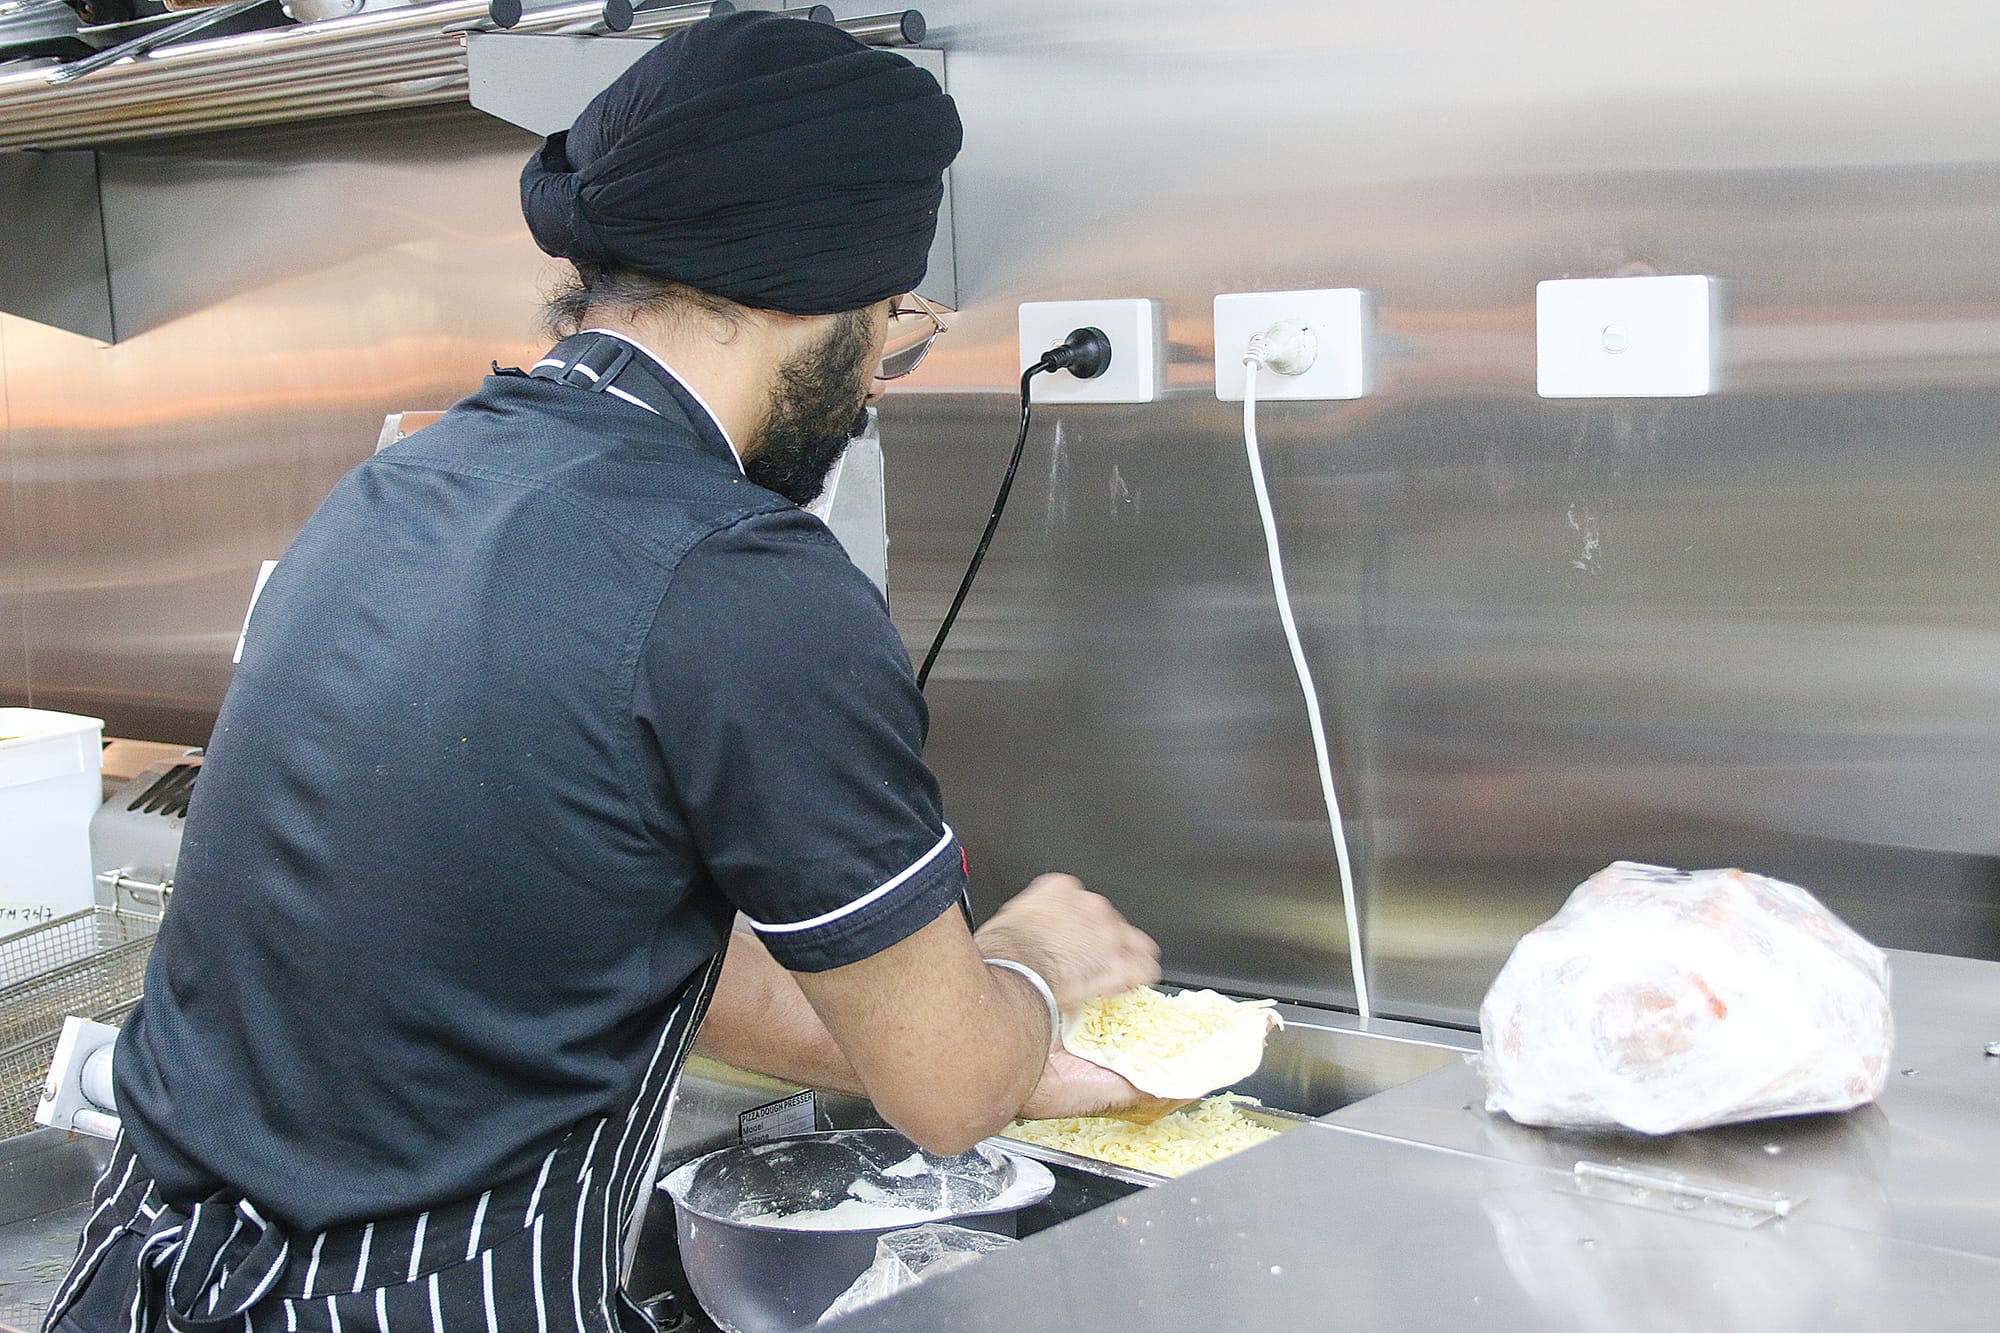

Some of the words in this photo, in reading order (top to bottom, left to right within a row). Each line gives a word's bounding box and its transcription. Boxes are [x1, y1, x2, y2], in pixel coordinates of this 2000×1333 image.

[742, 1111, 759, 1123] PIZZA
[760, 1103, 783, 1117] DOUGH
[784, 1093, 812, 1109] PRESSER
[743, 1122, 763, 1135] Model
